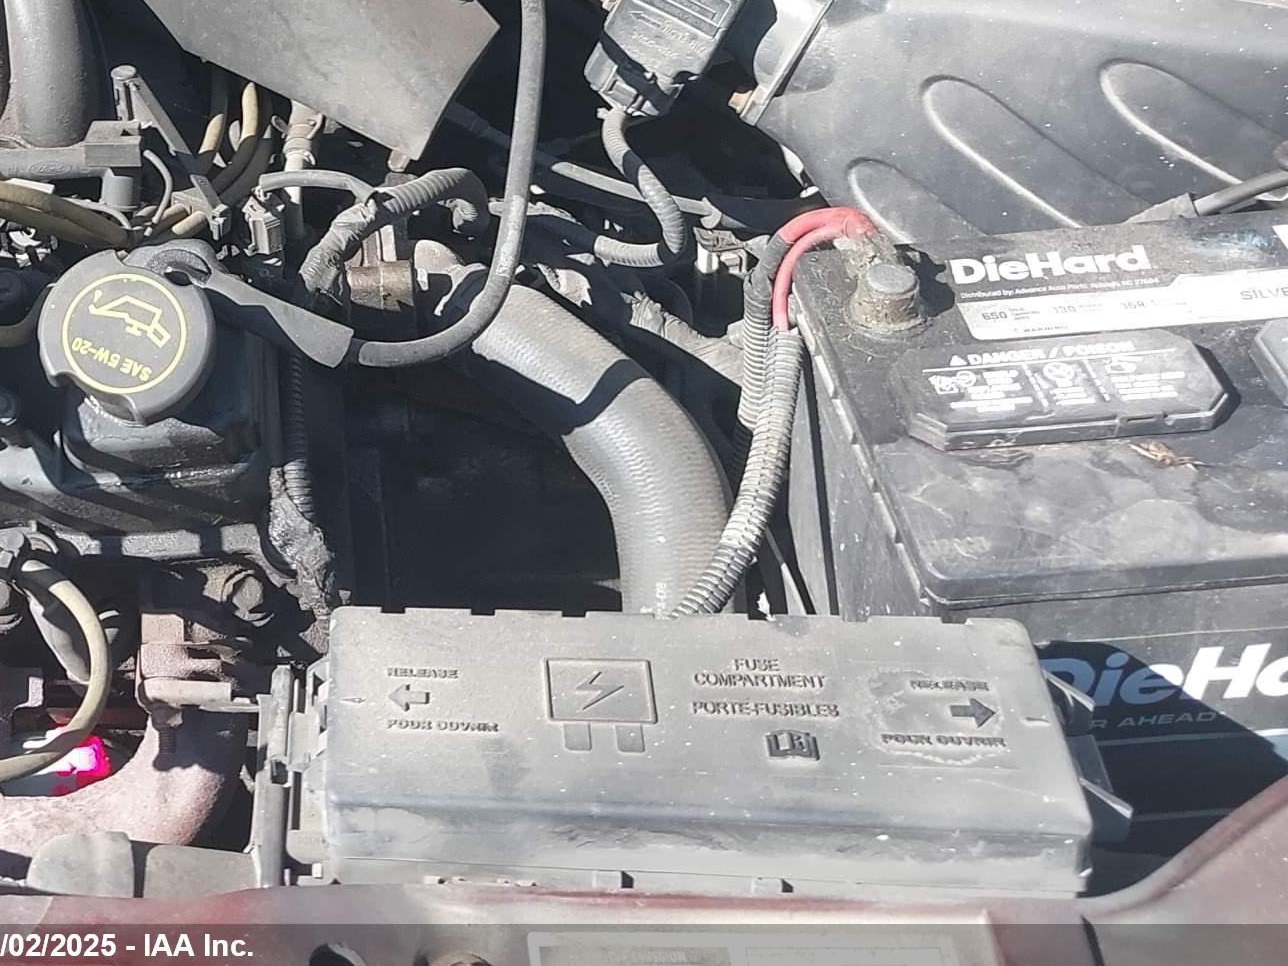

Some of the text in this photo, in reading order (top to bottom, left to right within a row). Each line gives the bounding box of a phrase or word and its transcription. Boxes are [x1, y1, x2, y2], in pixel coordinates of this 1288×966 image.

[949, 245, 1153, 284] DieHard
[982, 311, 1008, 321] 650
[71, 336, 152, 381] SAE 5W-20
[967, 348, 1047, 365] DANGER
[734, 658, 781, 672] FUSE
[387, 667, 459, 679] RELEASE
[694, 672, 826, 689] COMPARTMENT
[387, 719, 499, 733] POUR OUVRIR
[1117, 712, 1216, 728] AHEAD
[881, 733, 1007, 747] POUR OUVRIR
